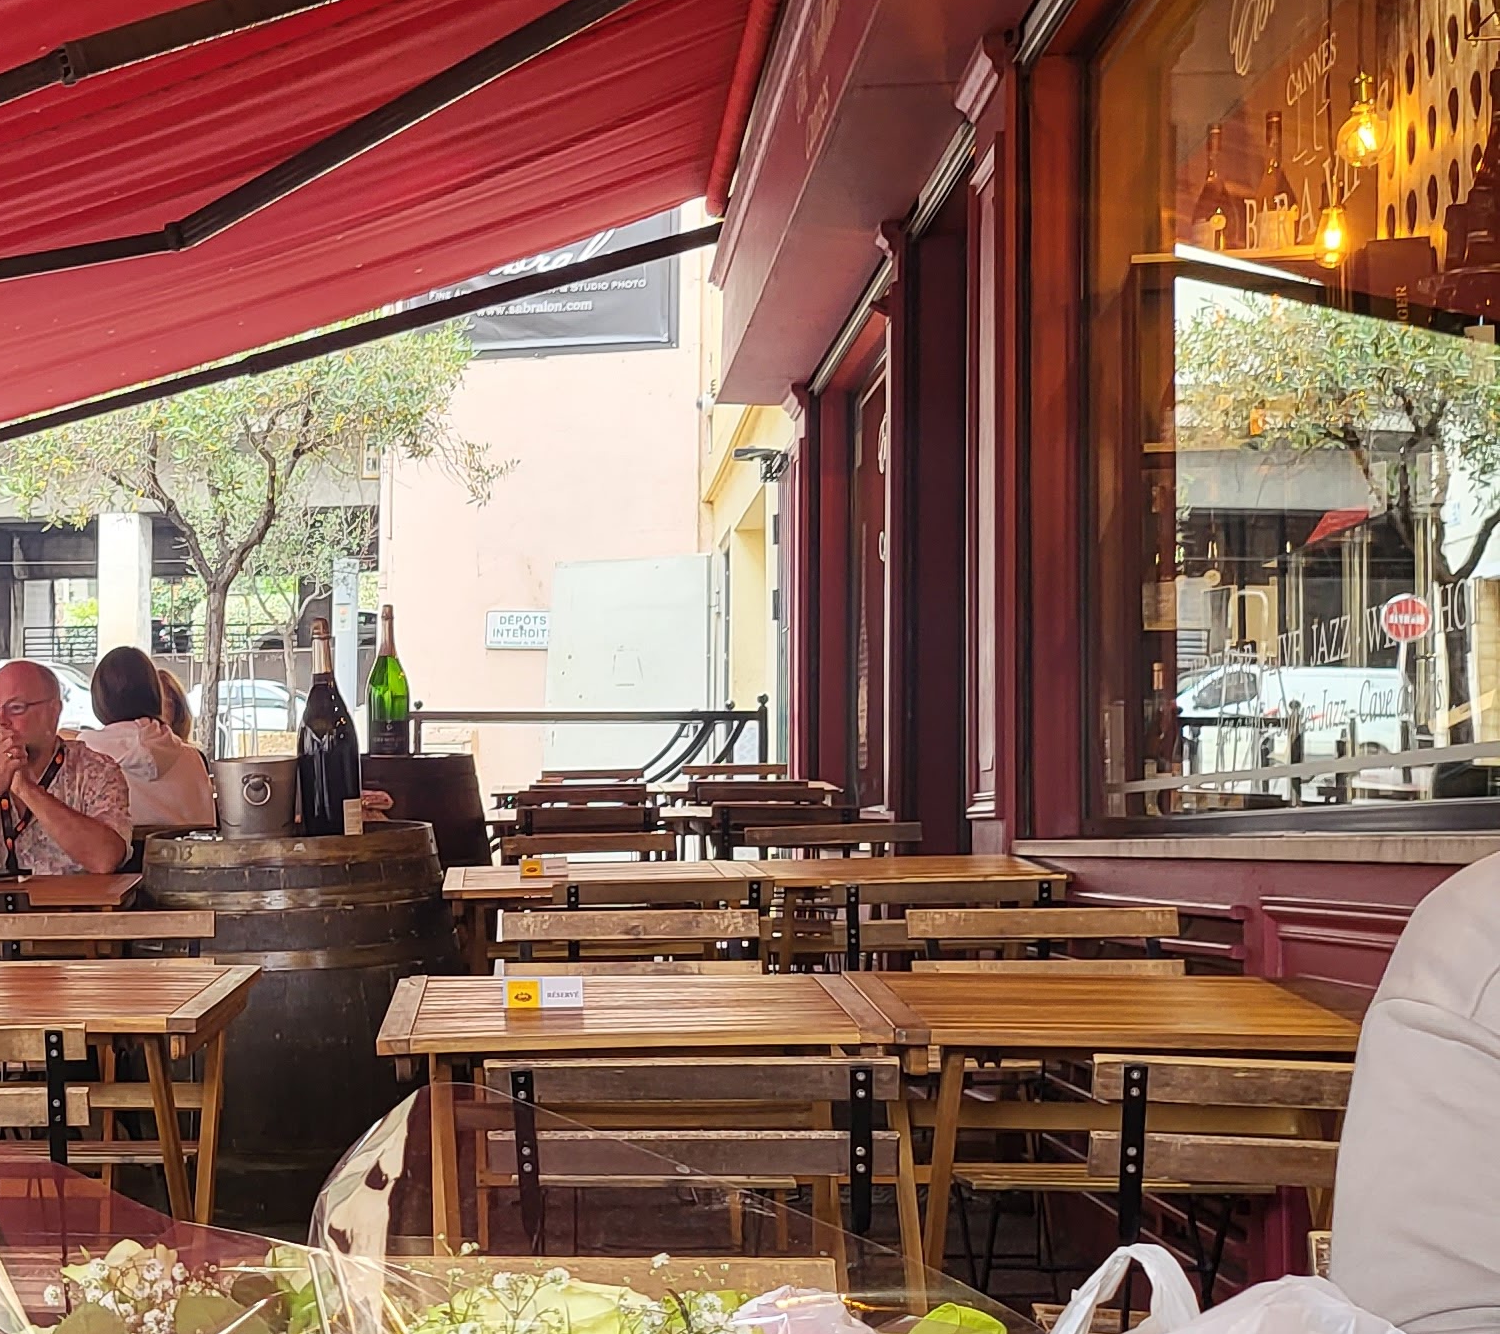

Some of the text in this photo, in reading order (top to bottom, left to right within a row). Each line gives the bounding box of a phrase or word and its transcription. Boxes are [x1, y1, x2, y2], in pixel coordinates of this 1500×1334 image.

[1286, 32, 1337, 106] CANNES
[492, 627, 550, 638] INTERDIT
[499, 614, 547, 625] DÉPÔTS
[1309, 615, 1351, 668] JAZZ
[1359, 679, 1394, 724] Cave
